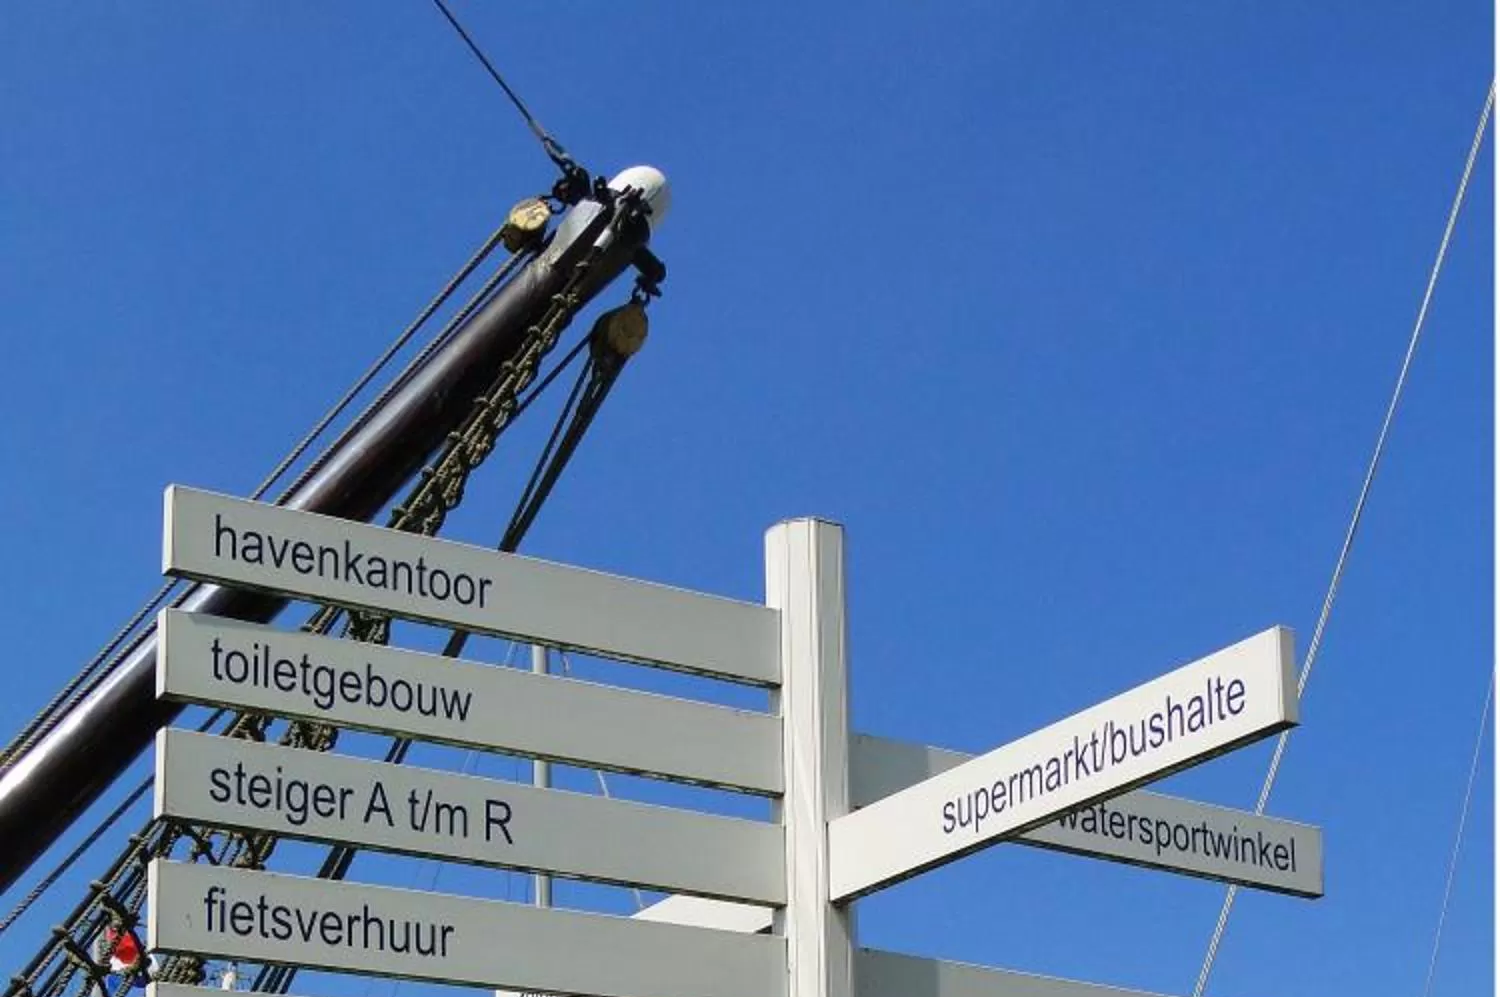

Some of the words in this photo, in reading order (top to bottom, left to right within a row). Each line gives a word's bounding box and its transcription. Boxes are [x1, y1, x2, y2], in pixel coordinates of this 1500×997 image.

[211, 514, 492, 608] havenkantoor
[210, 637, 473, 721] toiletgebouw
[941, 676, 1247, 834] supermarkt/bushalte
[208, 761, 355, 825] steiger
[363, 781, 395, 828] A
[407, 788, 469, 839] t/m
[484, 799, 514, 845] R
[203, 886, 455, 957] fietsverhuur
